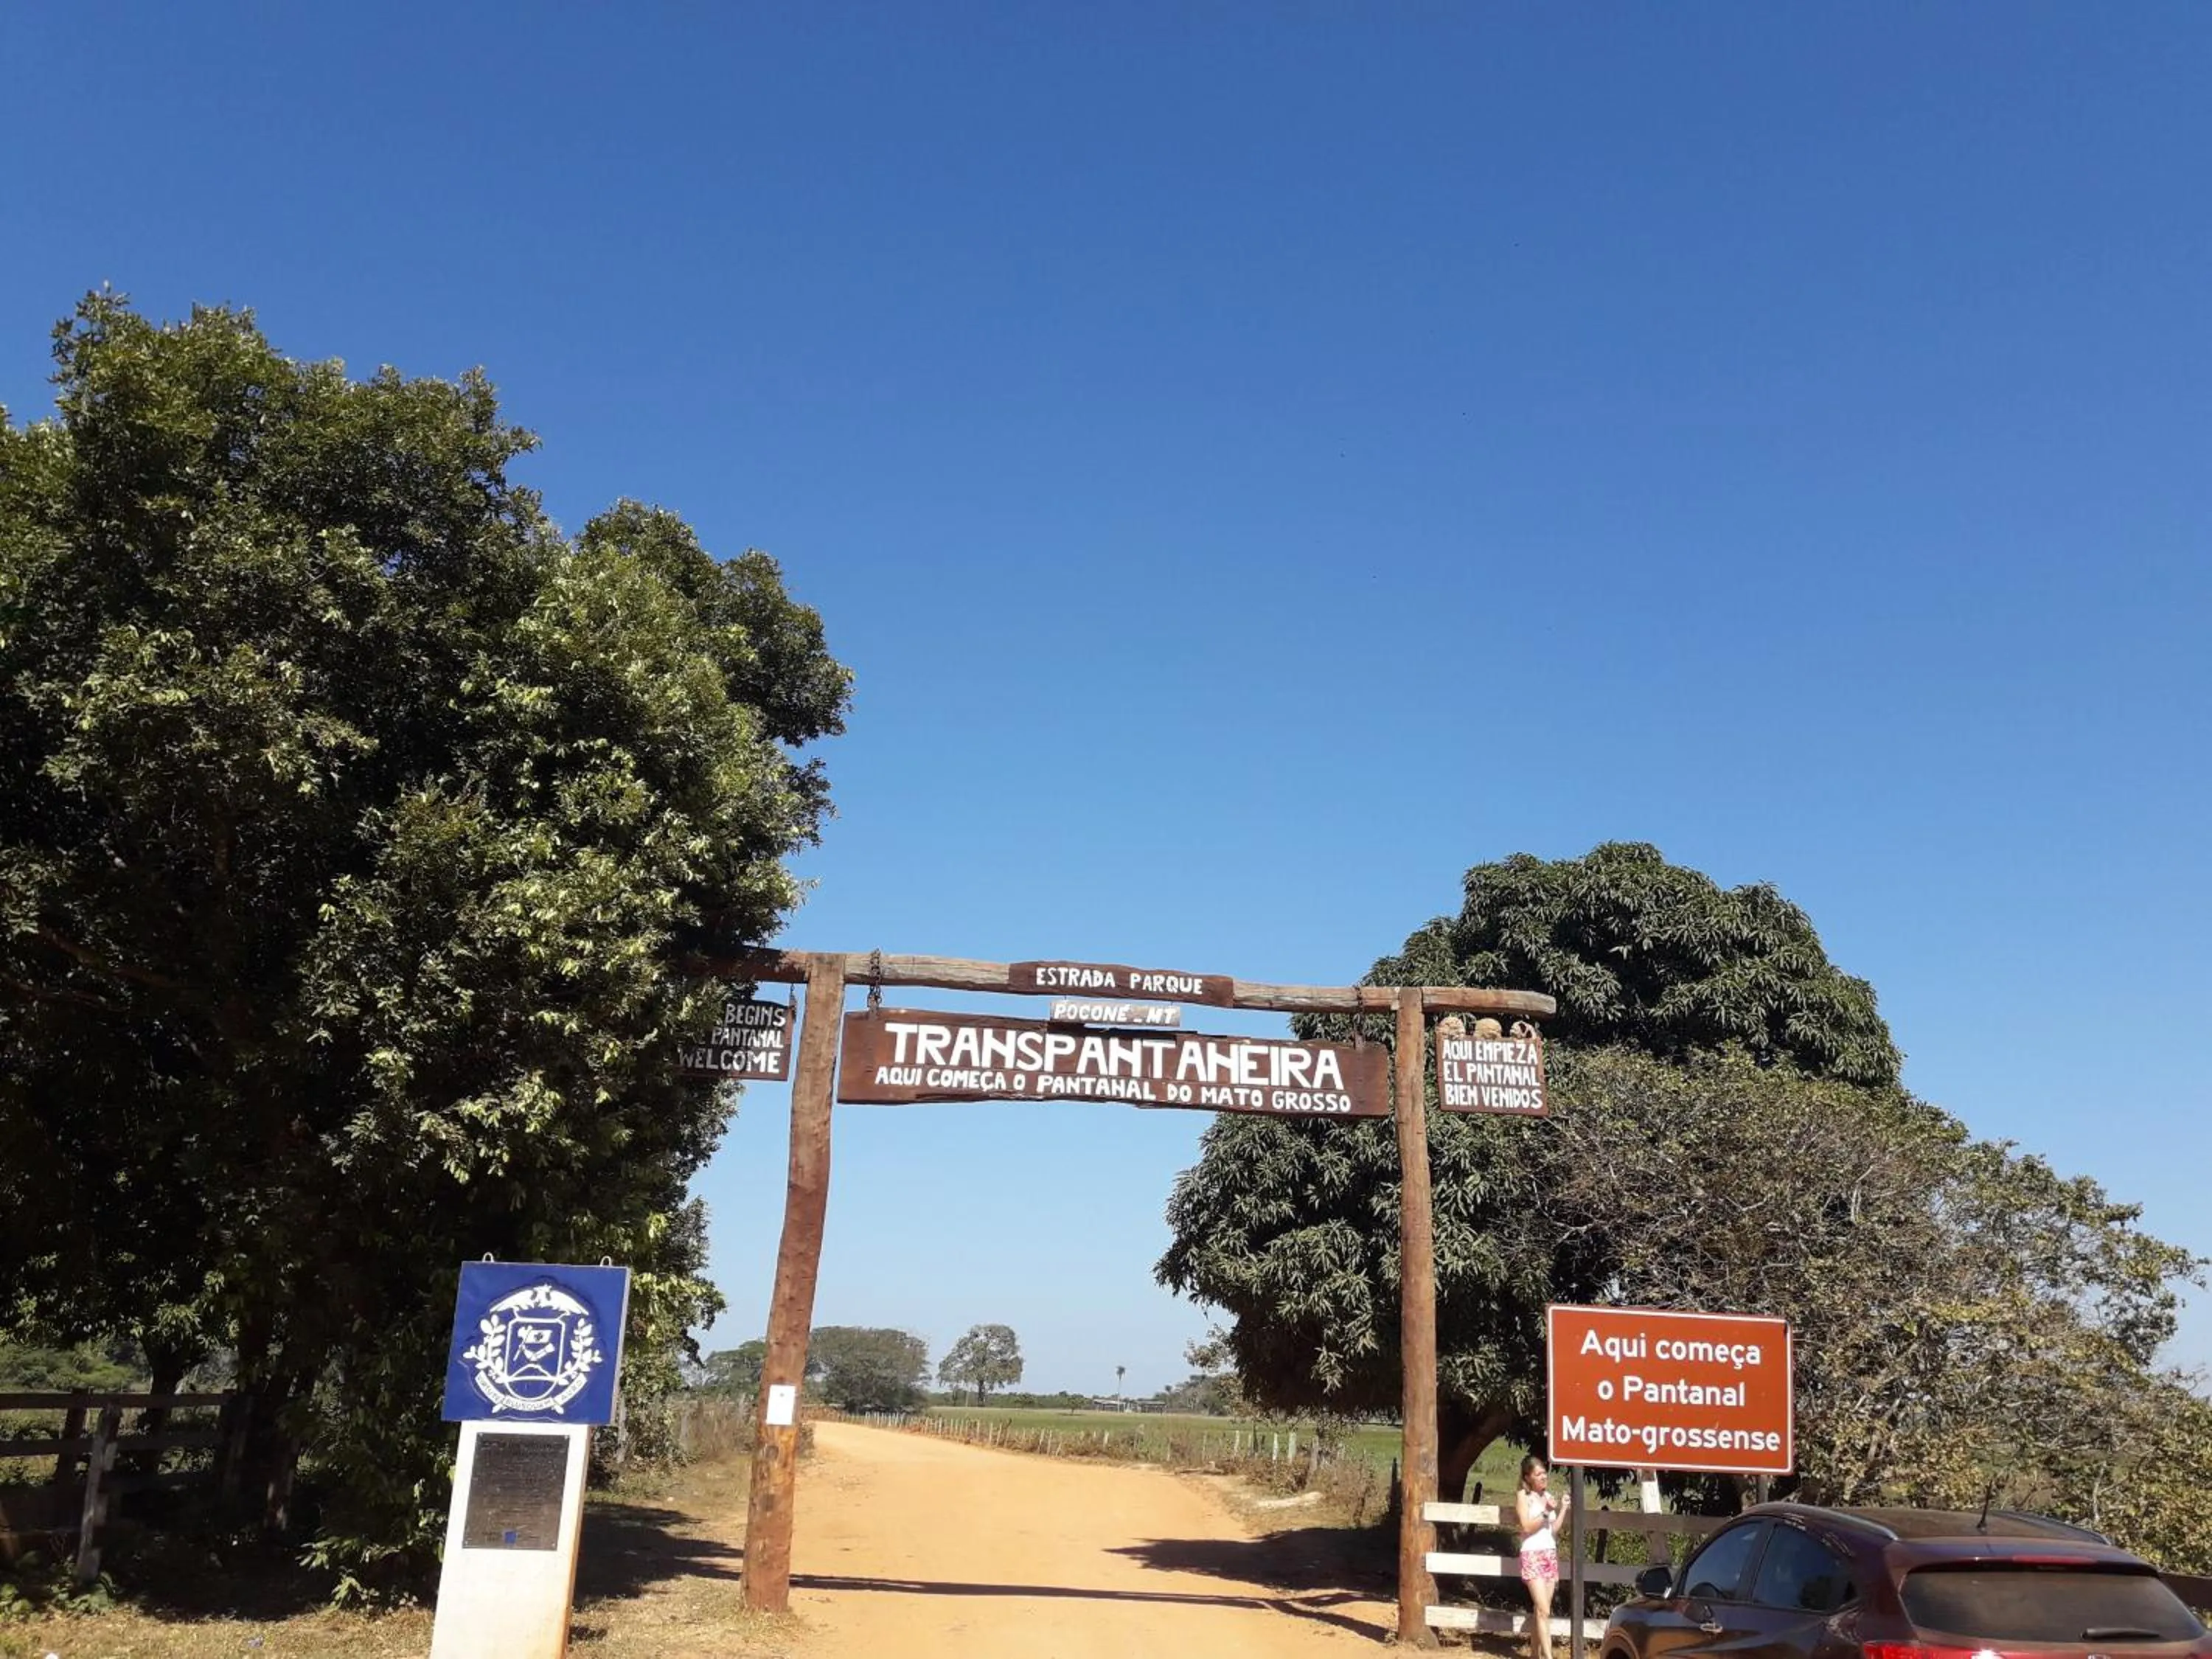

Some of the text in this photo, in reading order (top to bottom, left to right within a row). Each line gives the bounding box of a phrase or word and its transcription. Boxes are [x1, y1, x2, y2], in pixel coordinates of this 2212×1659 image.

[1036, 967, 1203, 995] ESTRADA PARQUE
[725, 1004, 786, 1026] BEGINS
[1053, 1003, 1132, 1023] POCONÉ
[711, 1026, 784, 1048] PANTANAL
[678, 1048, 782, 1073] WELCOME
[885, 1023, 1344, 1090] TRANSPANTANEIRA
[1442, 1039, 1538, 1065] AQUI EMPIEZA
[1443, 1061, 1541, 1087] EL PANTANAL
[874, 1066, 1351, 1112] AQUI COMEÇA O PANTANAL DO MATO GROSSO
[1444, 1084, 1543, 1110] BIEN VENIDOS
[1580, 1329, 1761, 1369] Aqui começa
[1597, 1375, 1746, 1407] o Pantanal
[1562, 1415, 1781, 1454] Mato-grossense
